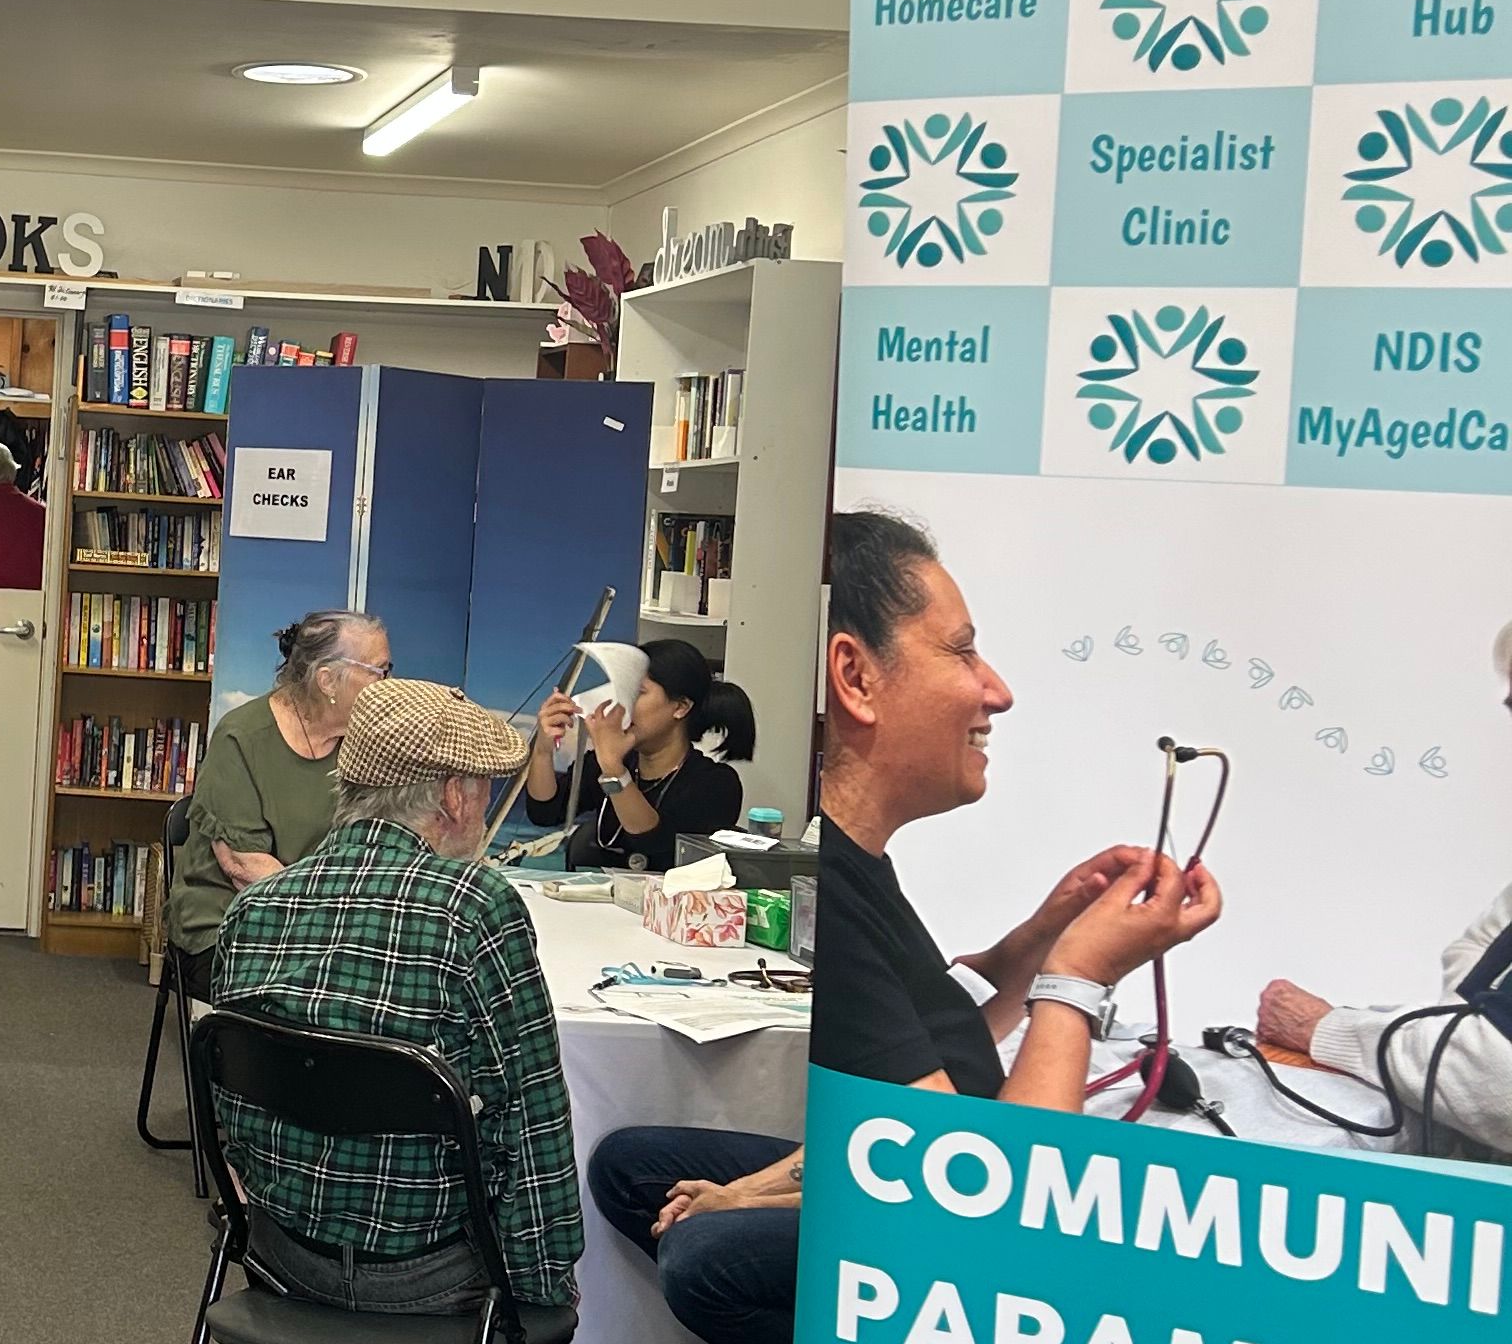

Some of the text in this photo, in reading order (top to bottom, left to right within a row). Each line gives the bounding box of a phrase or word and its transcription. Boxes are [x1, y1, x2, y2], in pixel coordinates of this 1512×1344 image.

[1090, 130, 1275, 183] Specialist
[1121, 205, 1231, 246] Clinic
[132, 338, 149, 387] ENGLISH
[877, 325, 990, 364] Mental
[1373, 331, 1483, 374] NDIS
[187, 340, 201, 396] DICTIONARY
[211, 344, 226, 395] THESAURUS
[871, 394, 977, 433] Health
[268, 467, 296, 481] EAR
[253, 493, 309, 507] CHECKS
[847, 1116, 1504, 1316] COMMUNI
